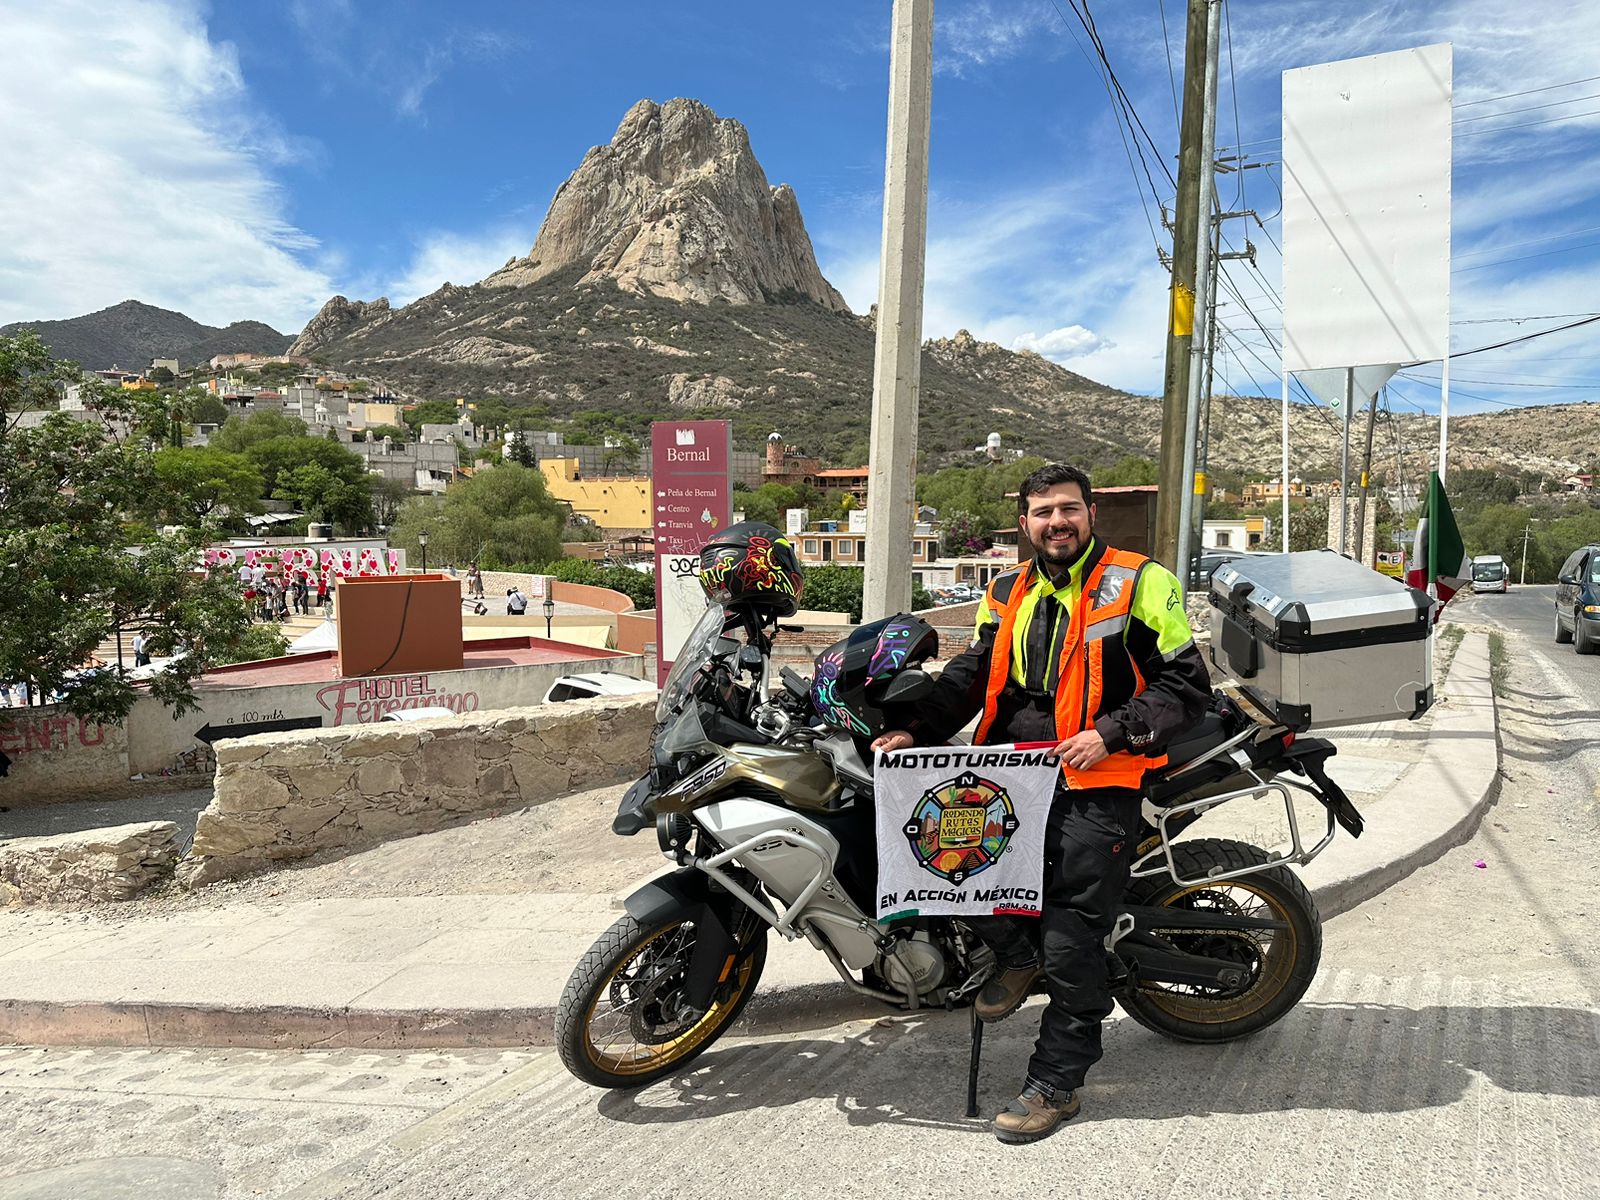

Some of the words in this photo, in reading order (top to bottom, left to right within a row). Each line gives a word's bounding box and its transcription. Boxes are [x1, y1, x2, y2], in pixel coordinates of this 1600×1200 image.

[667, 447, 711, 461] Bernal
[667, 488, 684, 497] Peña
[685, 489, 693, 497] de
[694, 488, 717, 497] Bernal
[667, 504, 690, 513] Centro
[1392, 555, 1399, 564] E
[359, 676, 436, 700] HOTEL
[241, 711, 259, 722] 100
[879, 752, 1061, 769] MOTOTURISMO
[961, 776, 974, 785] N
[906, 825, 918, 833] O
[1005, 821, 1016, 829] E
[954, 872, 963, 880] S
[880, 892, 898, 909] EN
[903, 889, 967, 903] ACCIÓN
[973, 885, 1039, 901] MÉXICO
